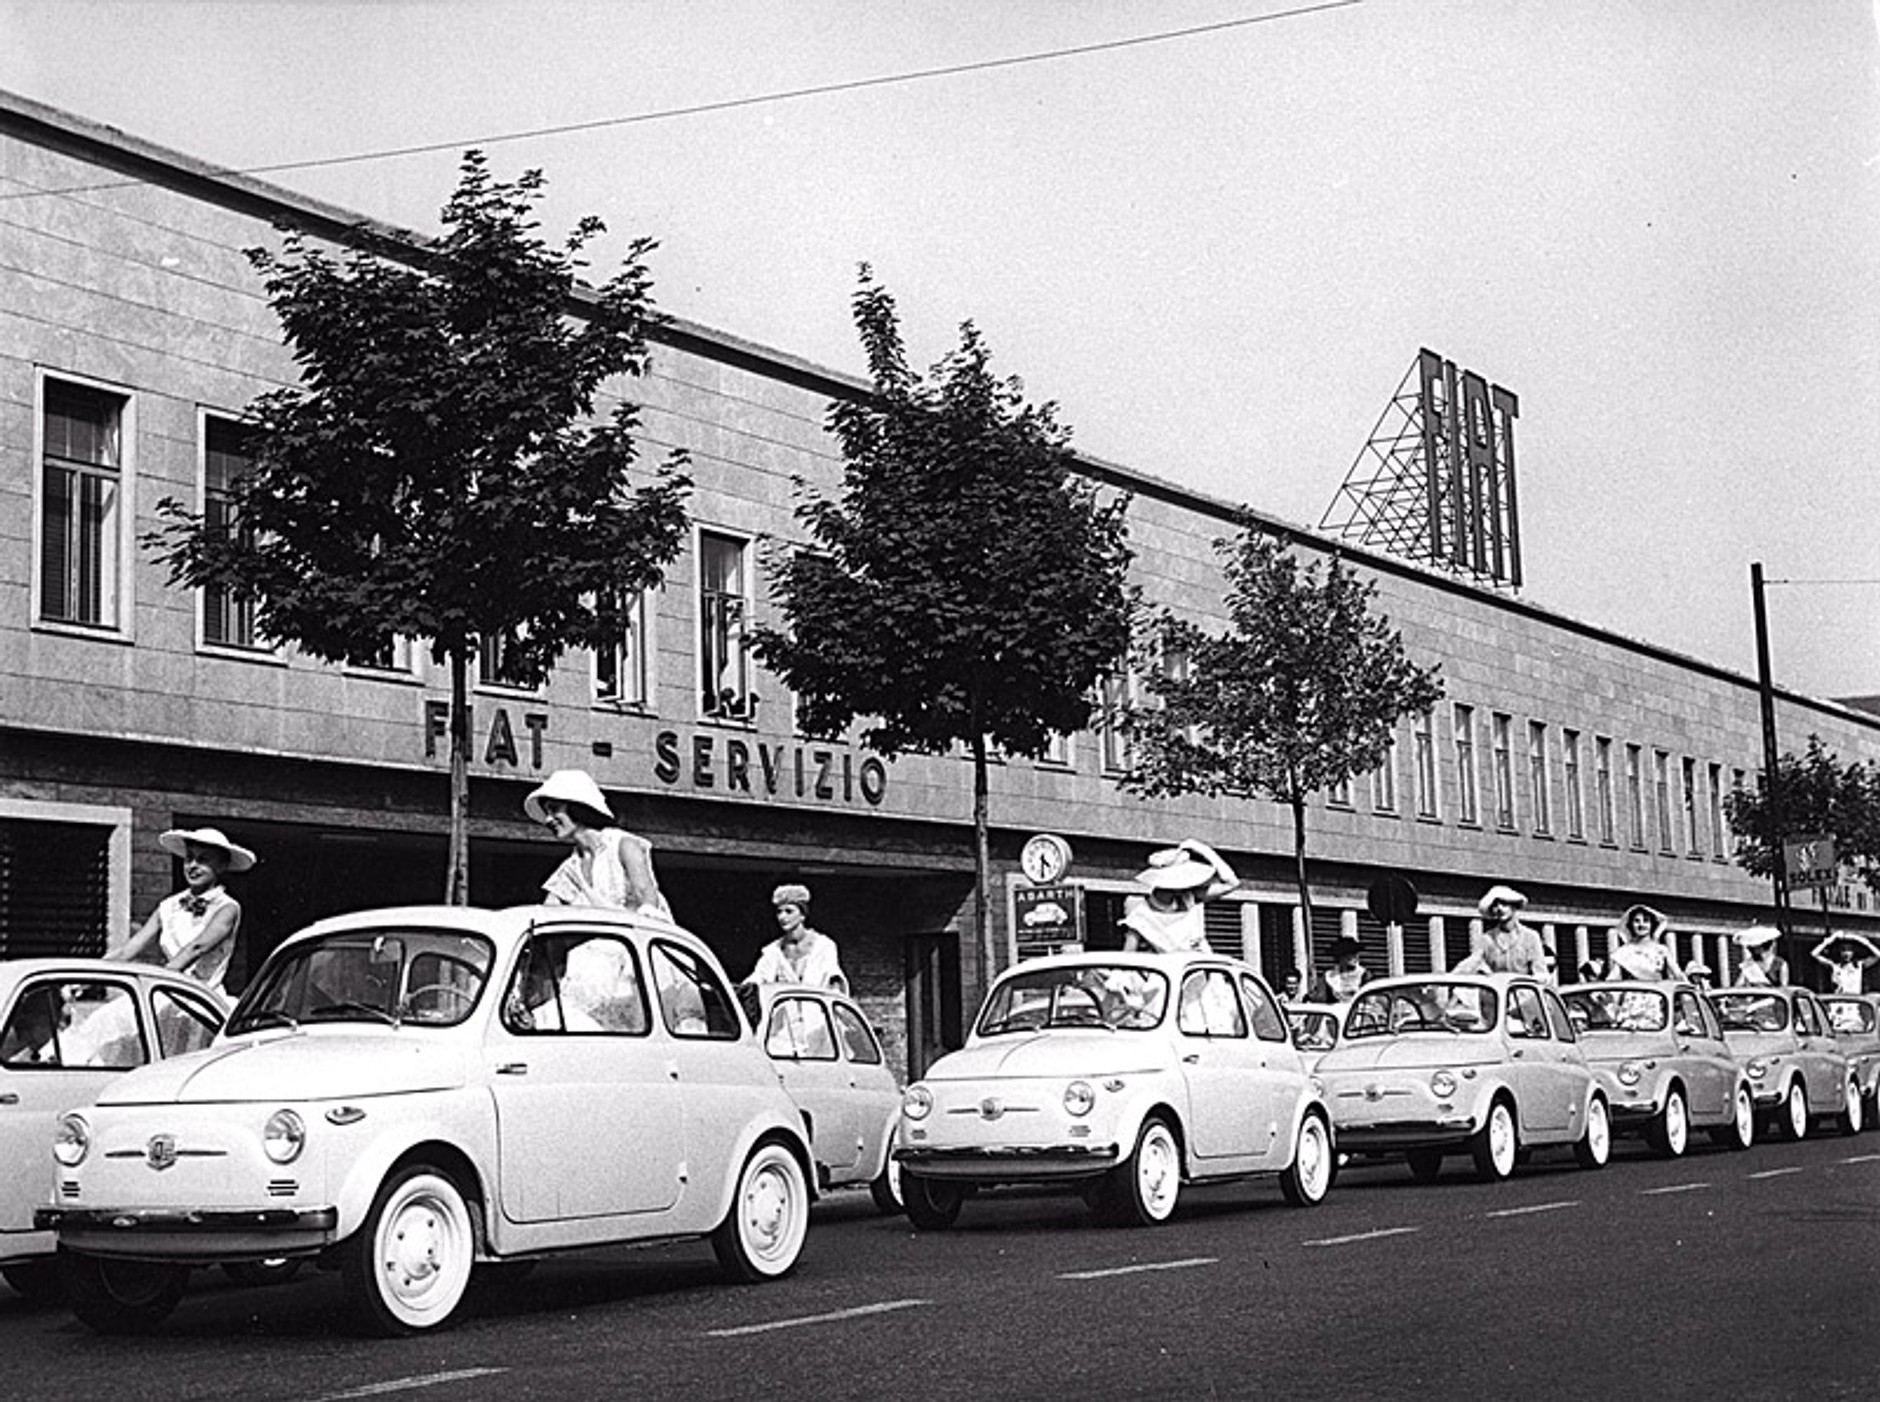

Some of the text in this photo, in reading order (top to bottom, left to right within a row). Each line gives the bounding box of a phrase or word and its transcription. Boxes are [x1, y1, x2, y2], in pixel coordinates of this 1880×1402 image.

[1420, 347, 1523, 587] FIAT
[655, 731, 887, 806] SERVIZIO
[1017, 889, 1074, 902] ABARTH
[1789, 869, 1832, 883] SOLEX
